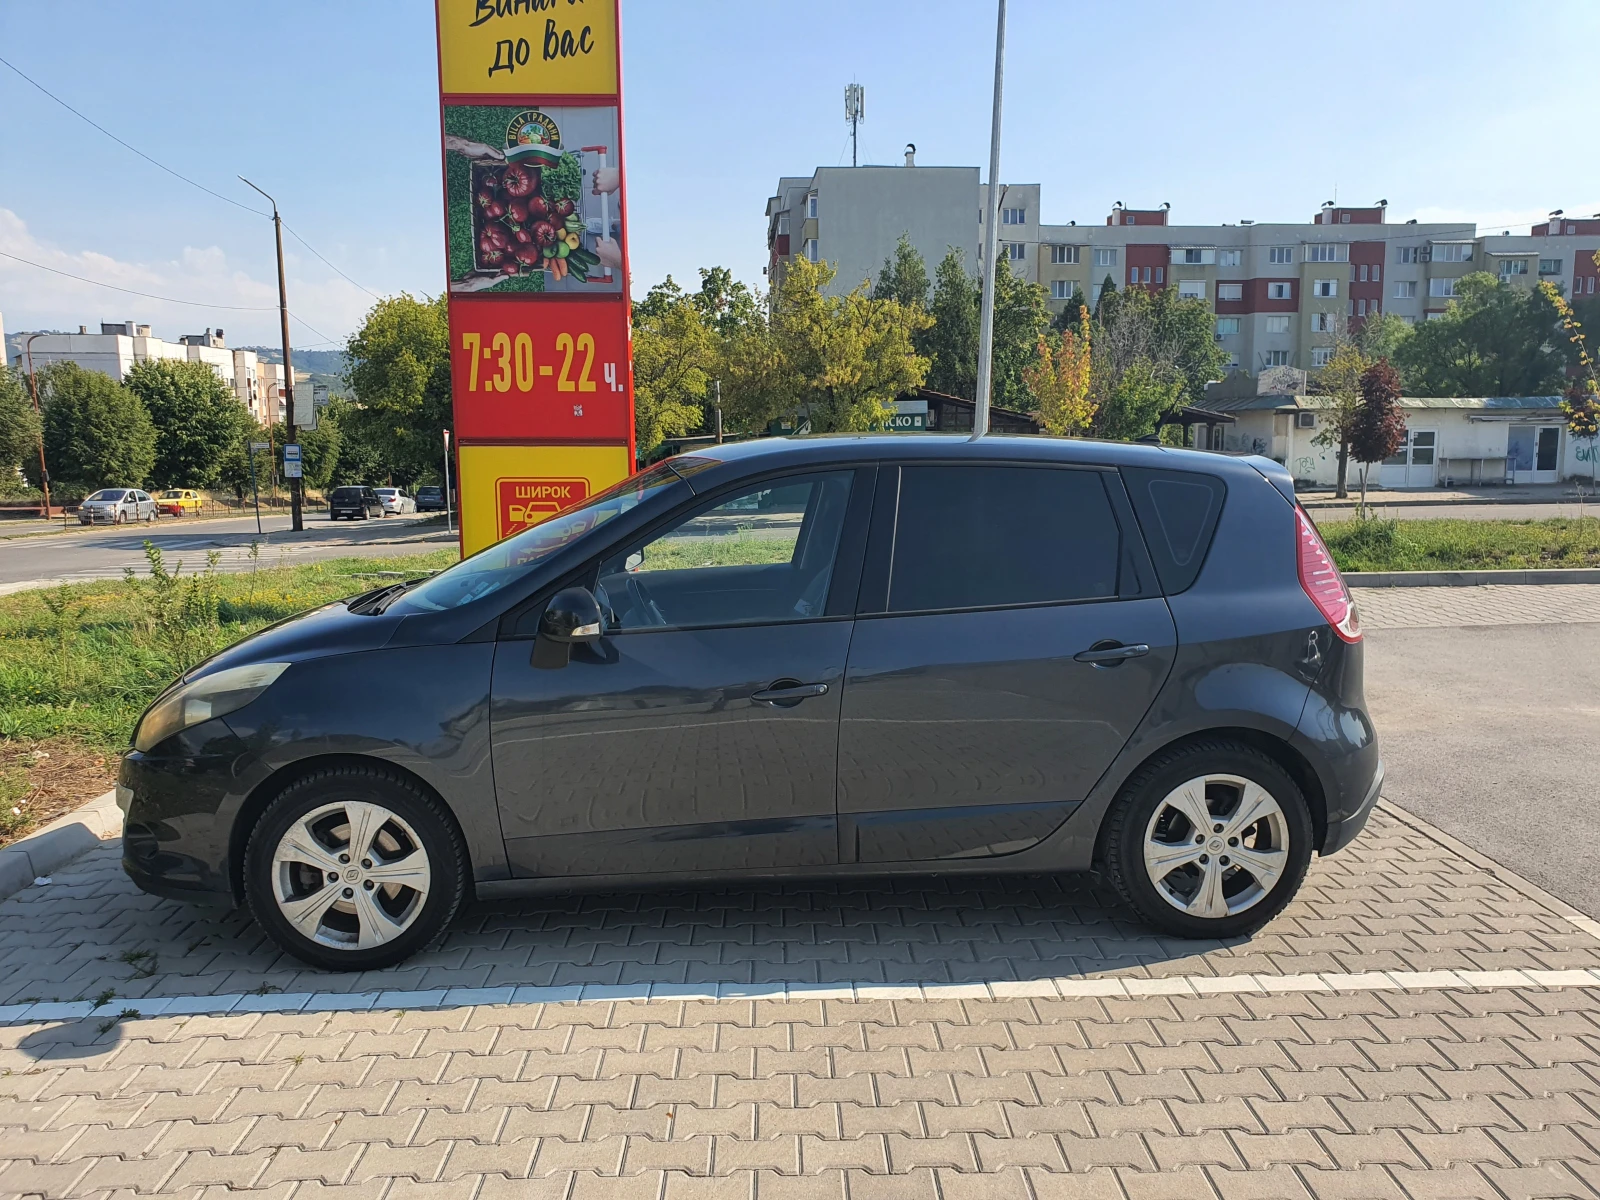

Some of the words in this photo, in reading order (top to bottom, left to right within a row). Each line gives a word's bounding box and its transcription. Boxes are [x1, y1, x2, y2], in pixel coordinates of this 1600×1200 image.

[469, 0, 584, 27] Вин
[543, 18, 594, 61] Вас
[508, 117, 525, 140] BILLA
[515, 486, 571, 499] ШИРОК
